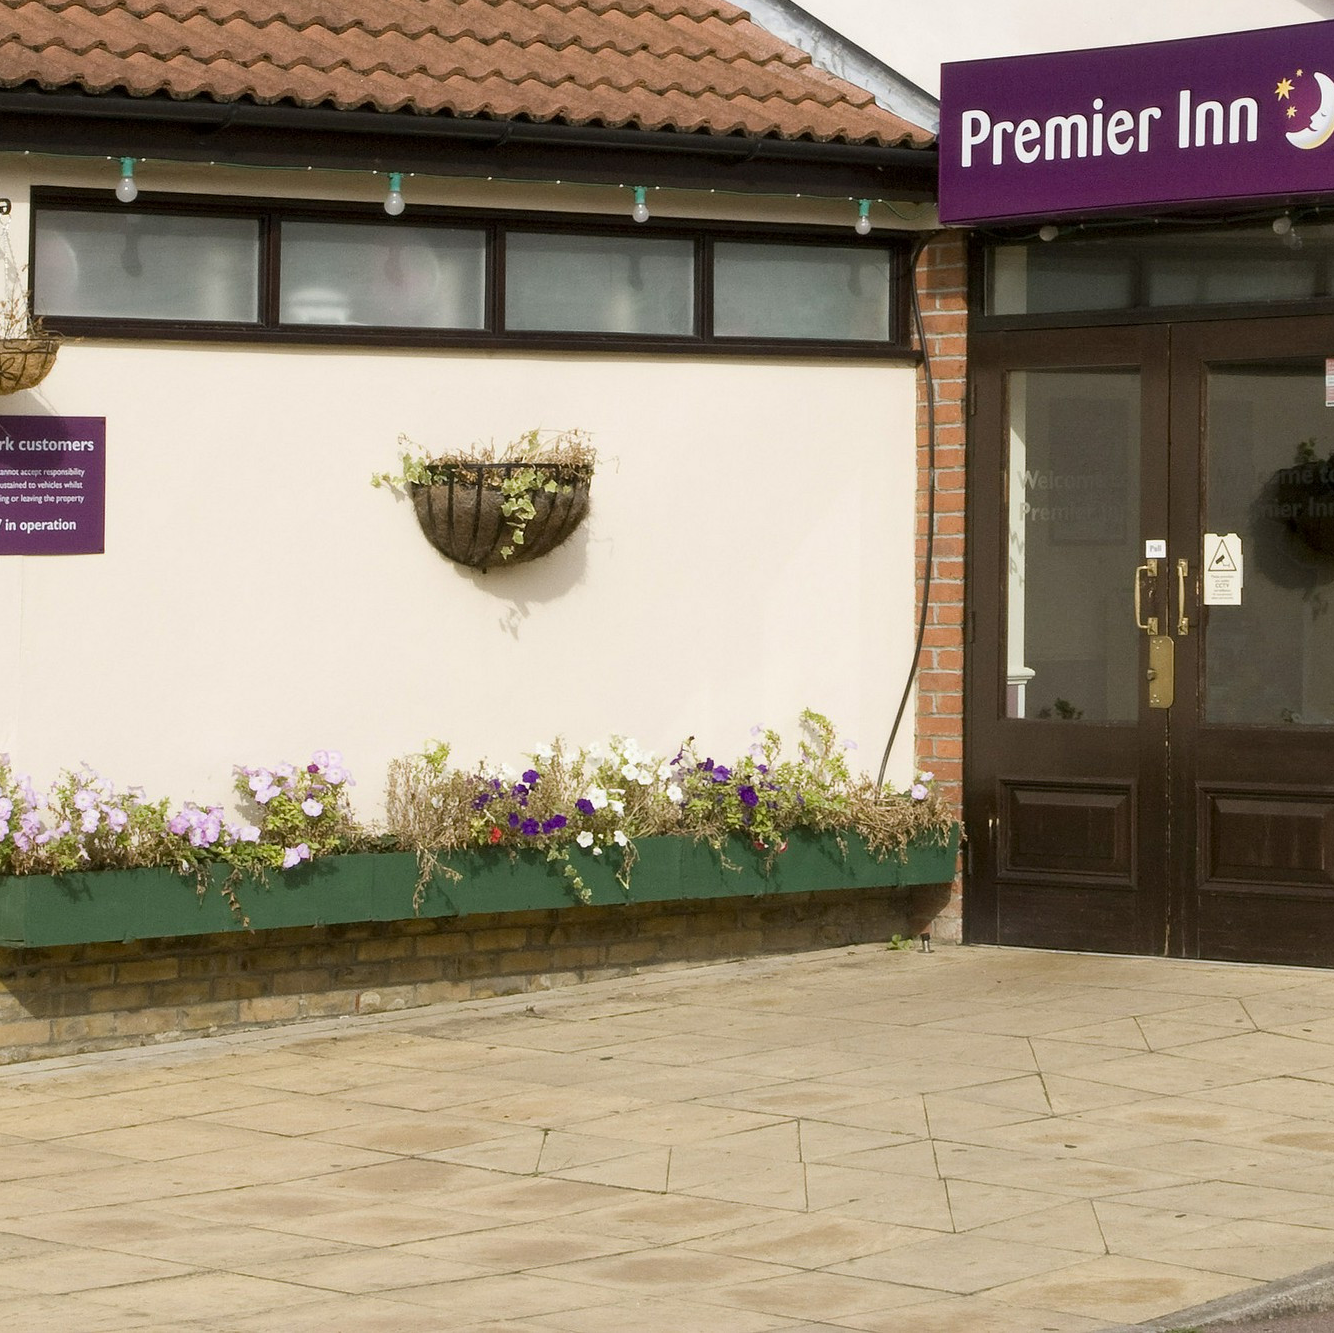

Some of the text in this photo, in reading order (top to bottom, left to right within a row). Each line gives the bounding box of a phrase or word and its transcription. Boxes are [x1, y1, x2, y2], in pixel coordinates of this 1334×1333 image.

[960, 89, 1259, 168] Premier Inn
[19, 438, 94, 452] customers
[20, 468, 42, 478] accept
[43, 467, 85, 478] responsibility
[37, 480, 62, 489] vehicles
[63, 480, 83, 489] whilst
[20, 494, 43, 505] leaving
[43, 494, 55, 503] the
[55, 495, 85, 505] property
[5, 518, 16, 531] in
[20, 518, 77, 534] operation
